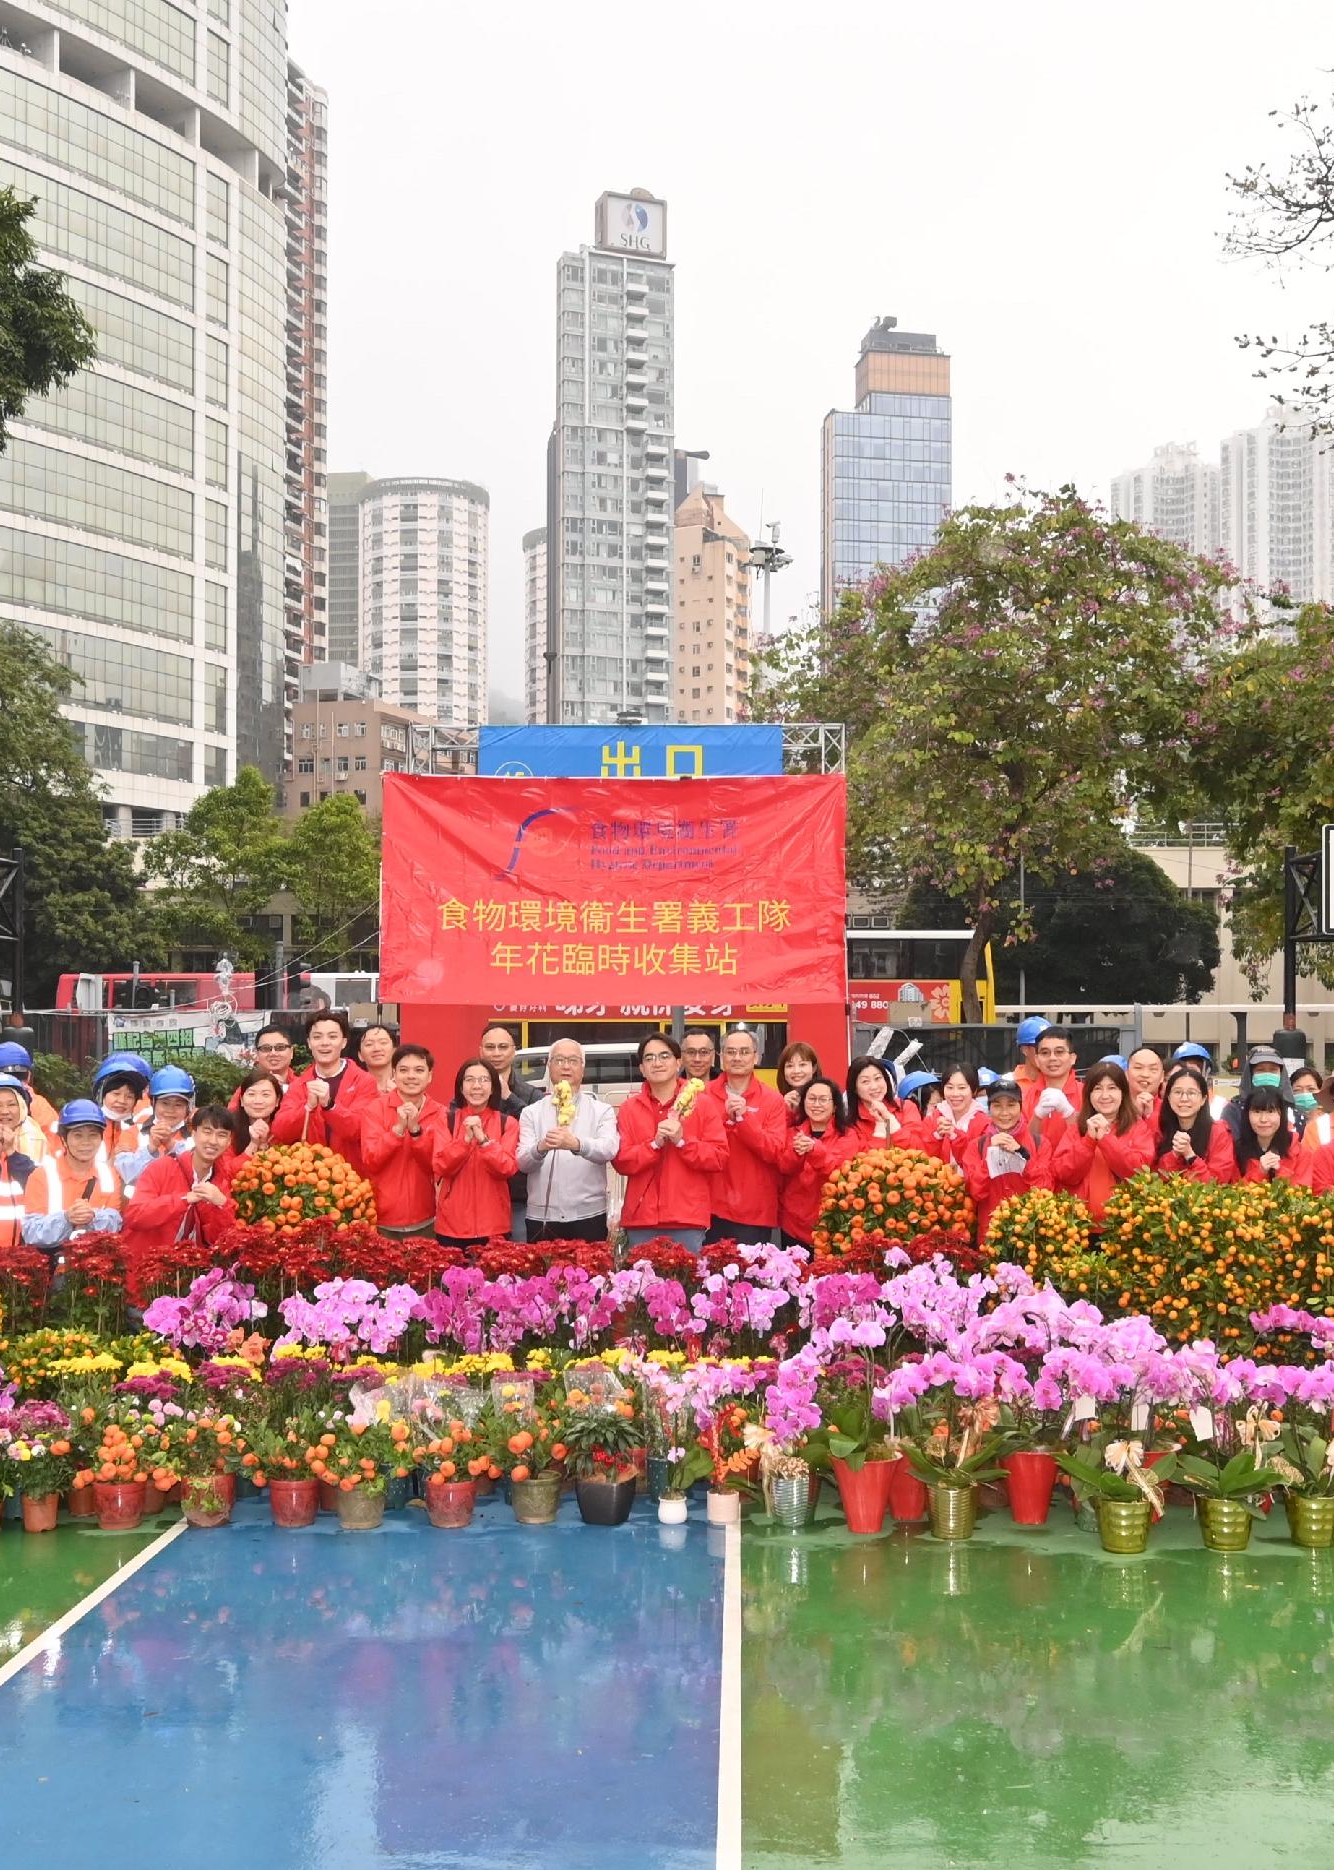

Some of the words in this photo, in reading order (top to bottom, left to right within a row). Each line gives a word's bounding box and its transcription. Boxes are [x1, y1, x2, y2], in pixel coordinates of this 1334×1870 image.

[620, 233, 651, 251] SHG
[601, 741, 703, 777] 出口
[491, 943, 738, 976] 年花臨時收集站
